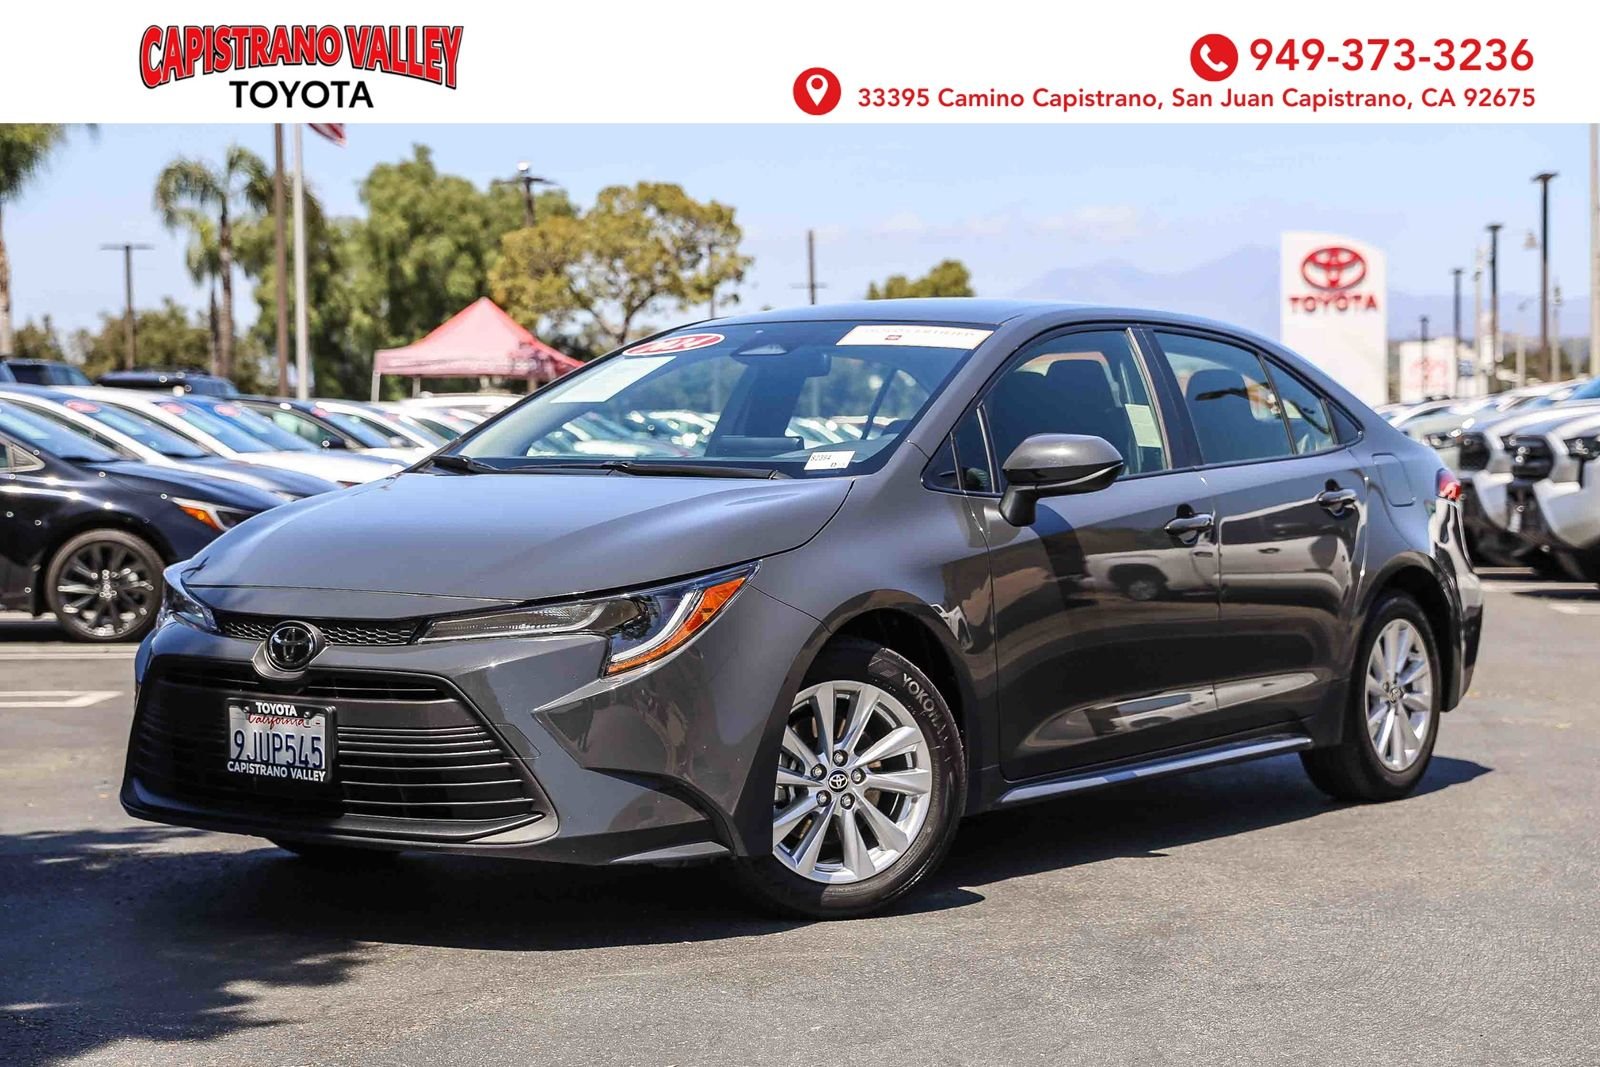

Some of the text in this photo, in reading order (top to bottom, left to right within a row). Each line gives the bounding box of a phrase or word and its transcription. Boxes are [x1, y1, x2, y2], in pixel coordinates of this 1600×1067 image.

[1288, 295, 1379, 312] TOYOTA
[255, 702, 298, 717] TOYOTA
[233, 730, 323, 769] 9JUP545
[227, 761, 326, 782] CAPISTRANO VALLEY
